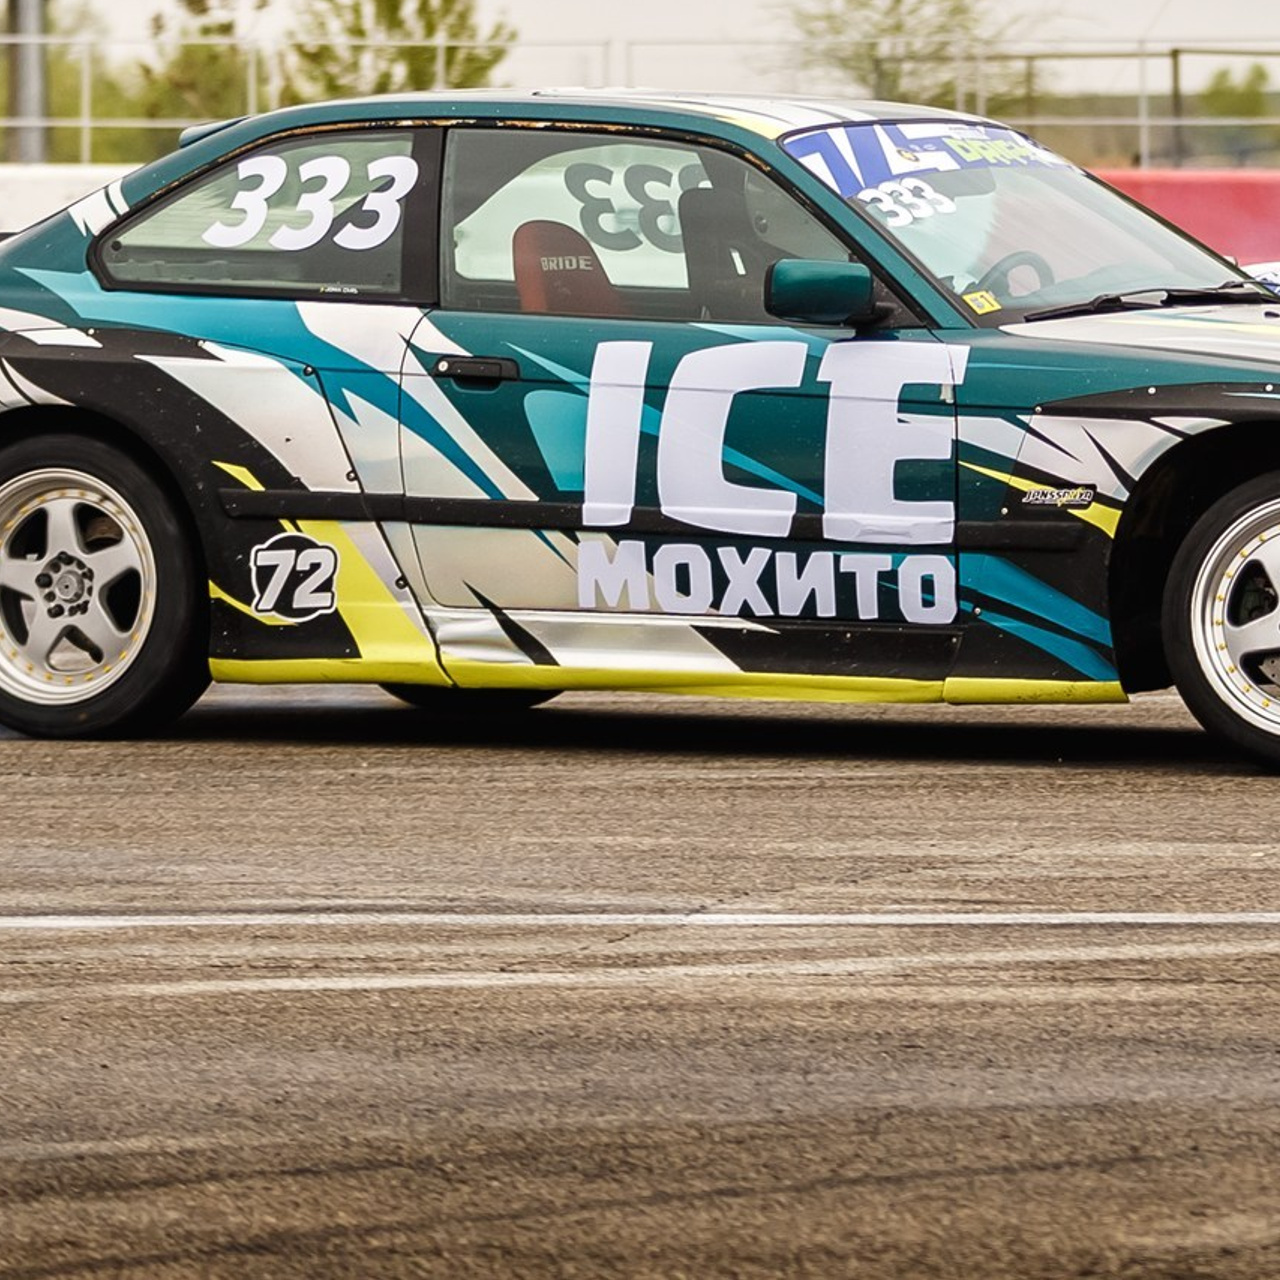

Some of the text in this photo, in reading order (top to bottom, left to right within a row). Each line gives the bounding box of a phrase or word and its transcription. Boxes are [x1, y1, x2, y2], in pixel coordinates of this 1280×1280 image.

[201, 155, 419, 251] 333
[857, 177, 956, 227] 333
[540, 255, 594, 271] BRIDE
[582, 341, 971, 545] ICE
[256, 548, 336, 611] 72
[577, 540, 958, 625] МОХИТО
